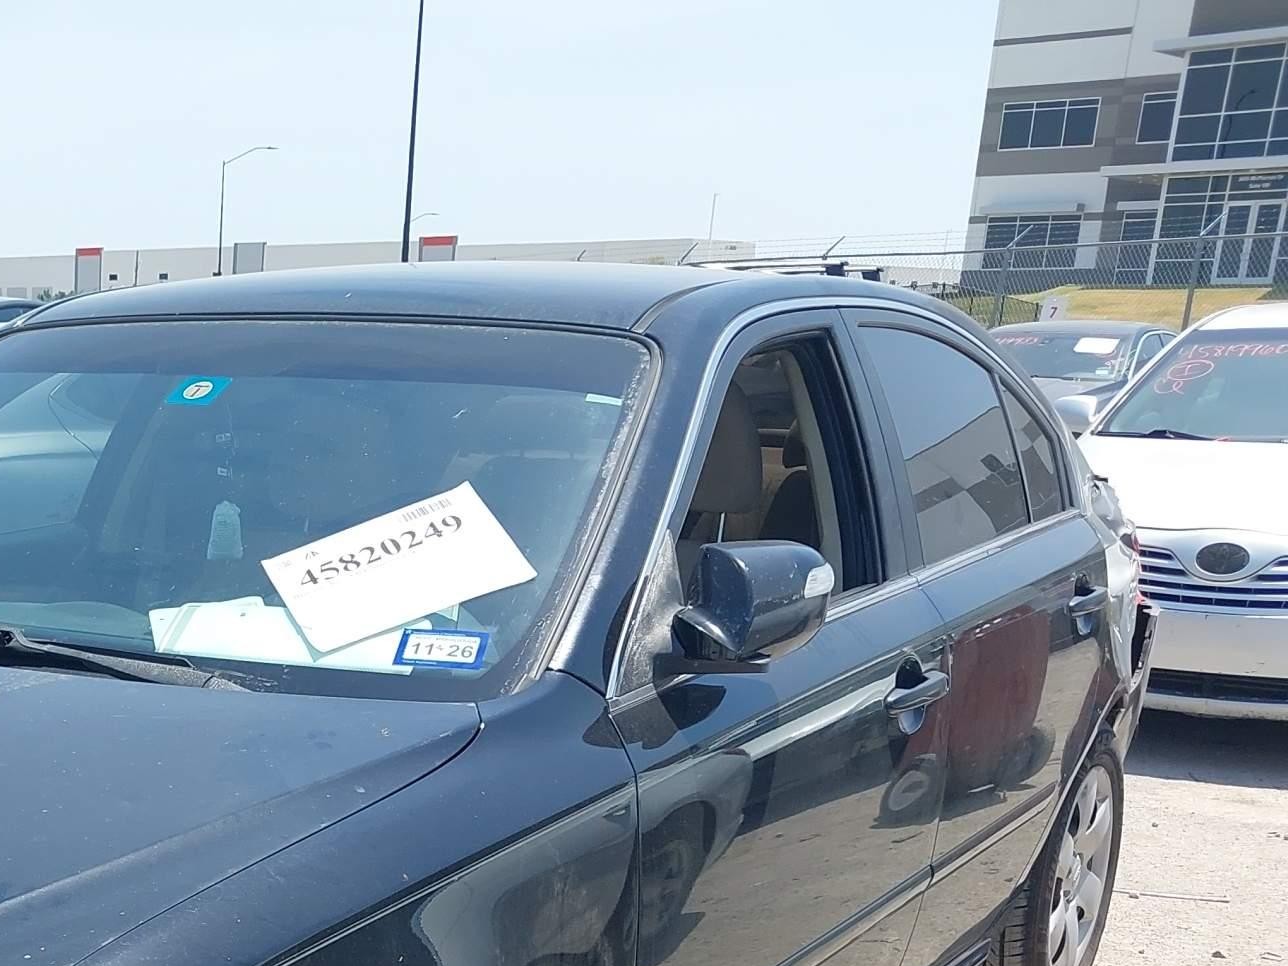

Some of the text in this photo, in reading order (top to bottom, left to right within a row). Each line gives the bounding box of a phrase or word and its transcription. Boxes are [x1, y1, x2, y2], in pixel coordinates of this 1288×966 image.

[1050, 306, 1058, 318] 7
[300, 514, 463, 586] 45820249
[412, 642, 474, 658] 11 26
